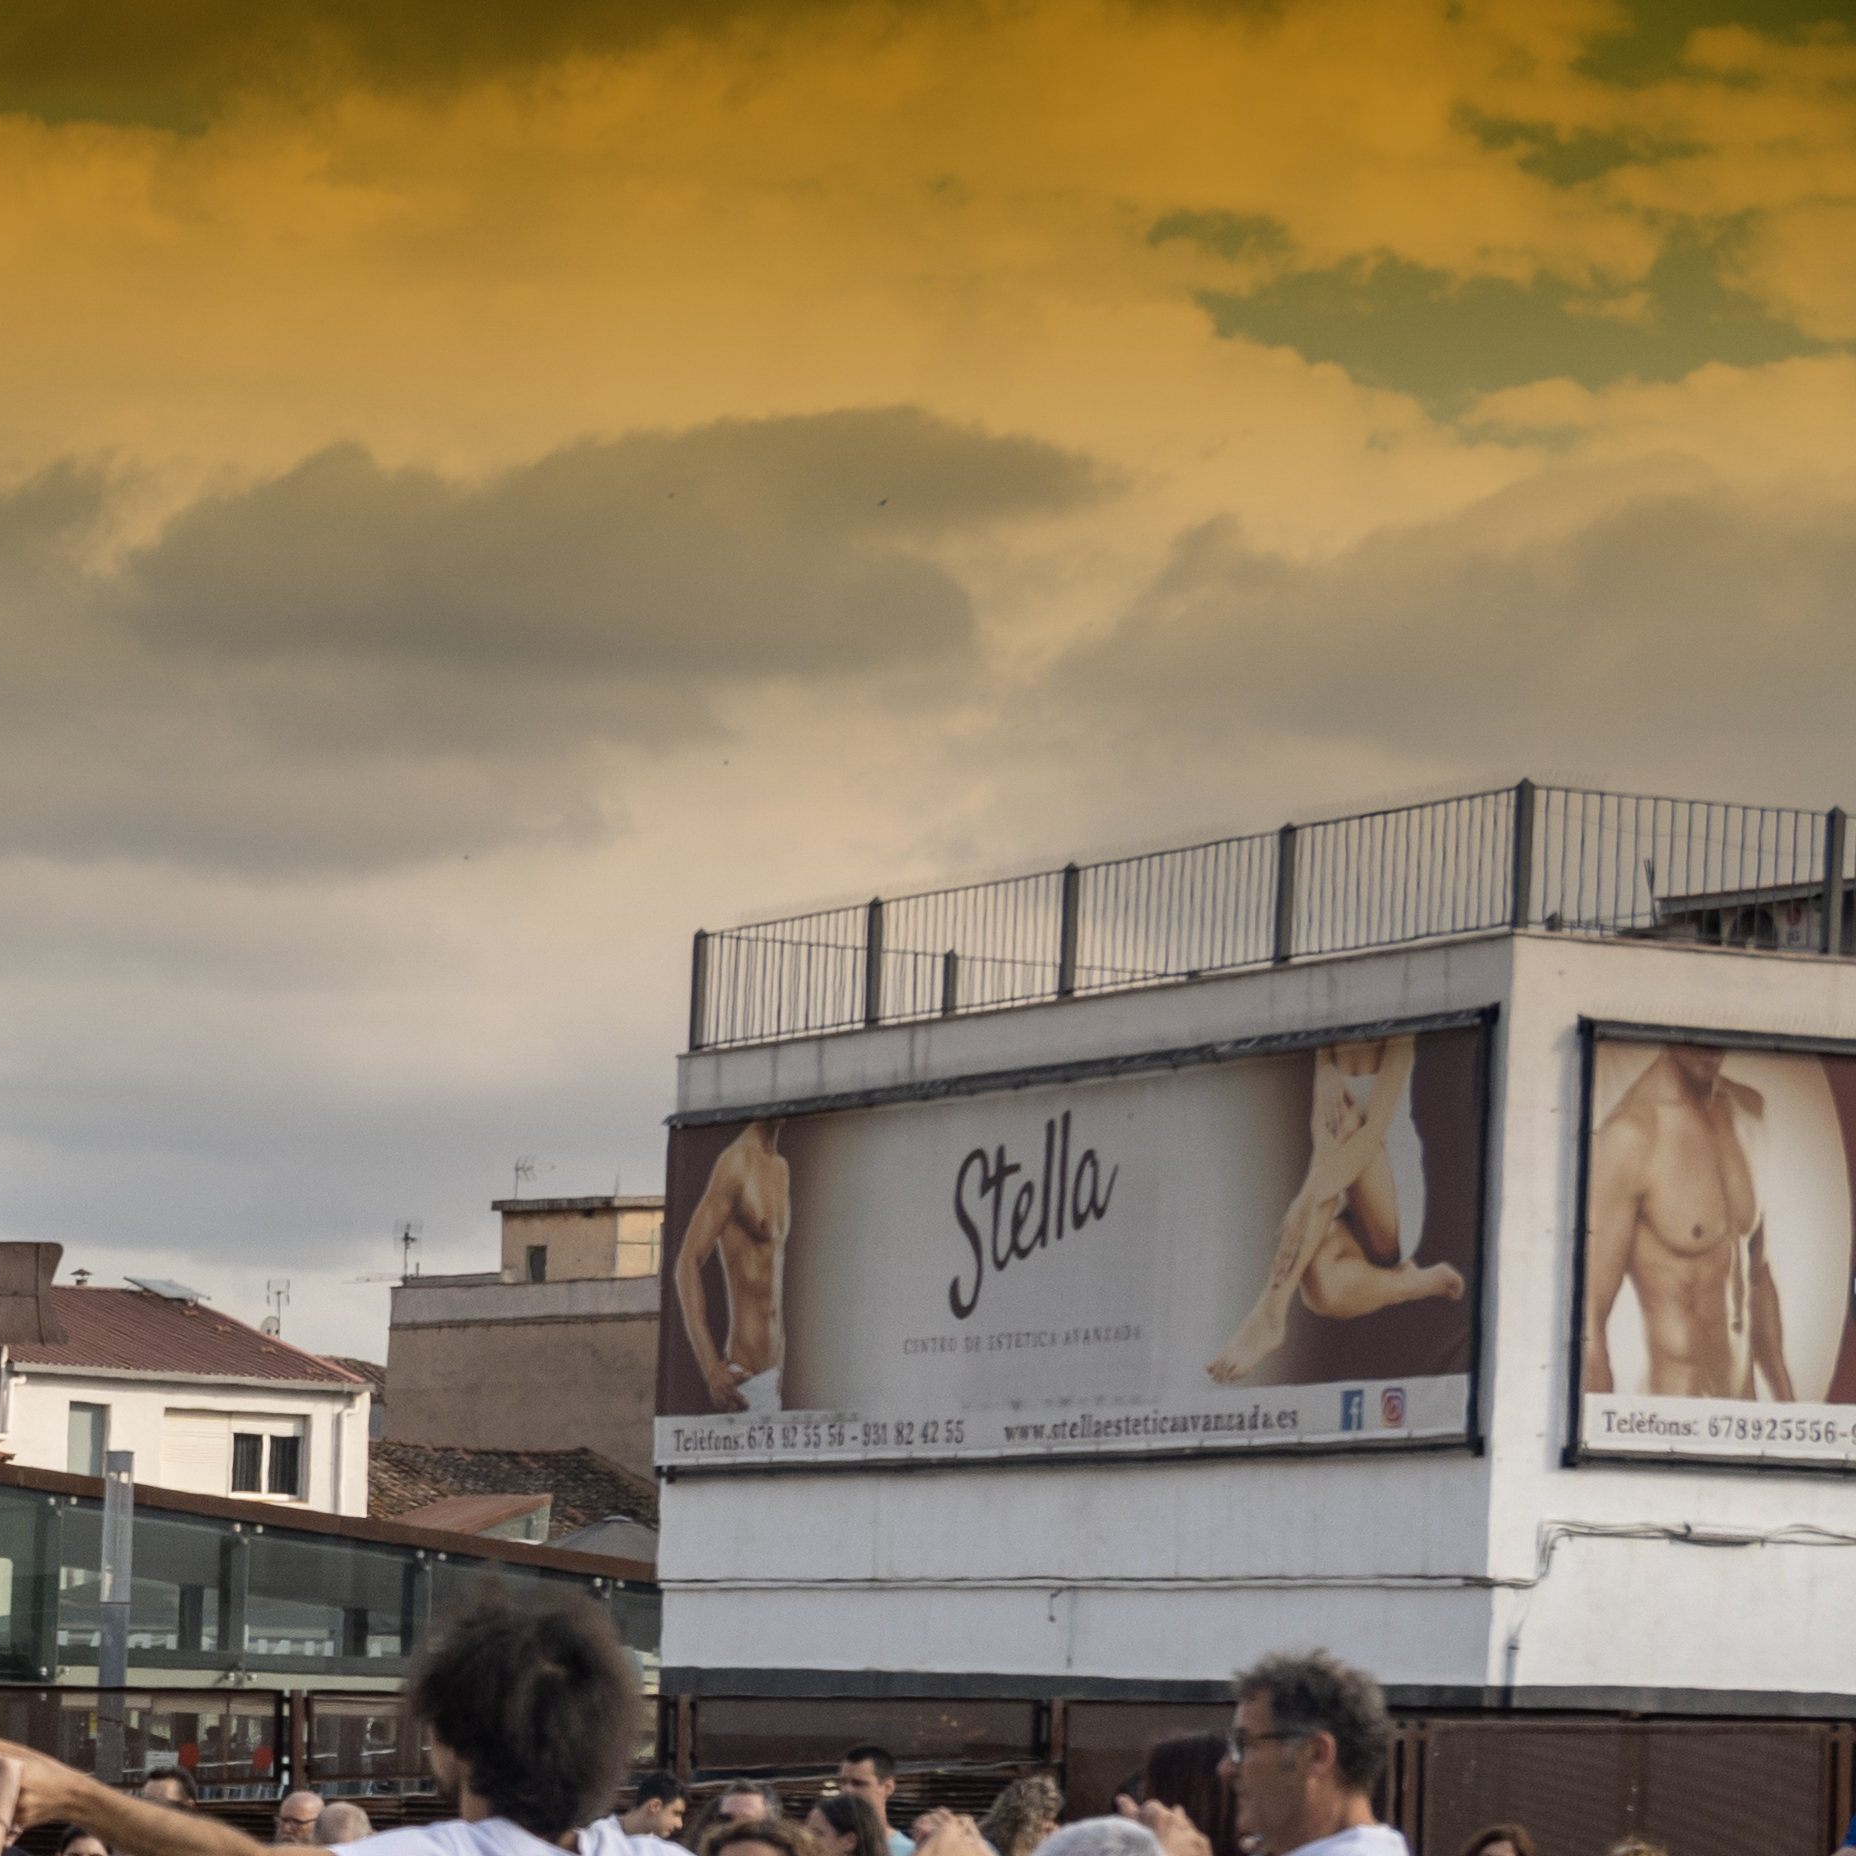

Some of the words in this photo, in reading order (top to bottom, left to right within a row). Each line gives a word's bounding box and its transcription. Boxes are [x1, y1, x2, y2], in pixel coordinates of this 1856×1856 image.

[948, 1109, 1119, 1320] Stella
[747, 1426, 774, 1450] 678
[804, 1424, 821, 1448] 55
[894, 1420, 914, 1445] 82
[921, 1420, 939, 1444] 42
[945, 1419, 965, 1444] 55
[1602, 1409, 1699, 1437] Telèfons:
